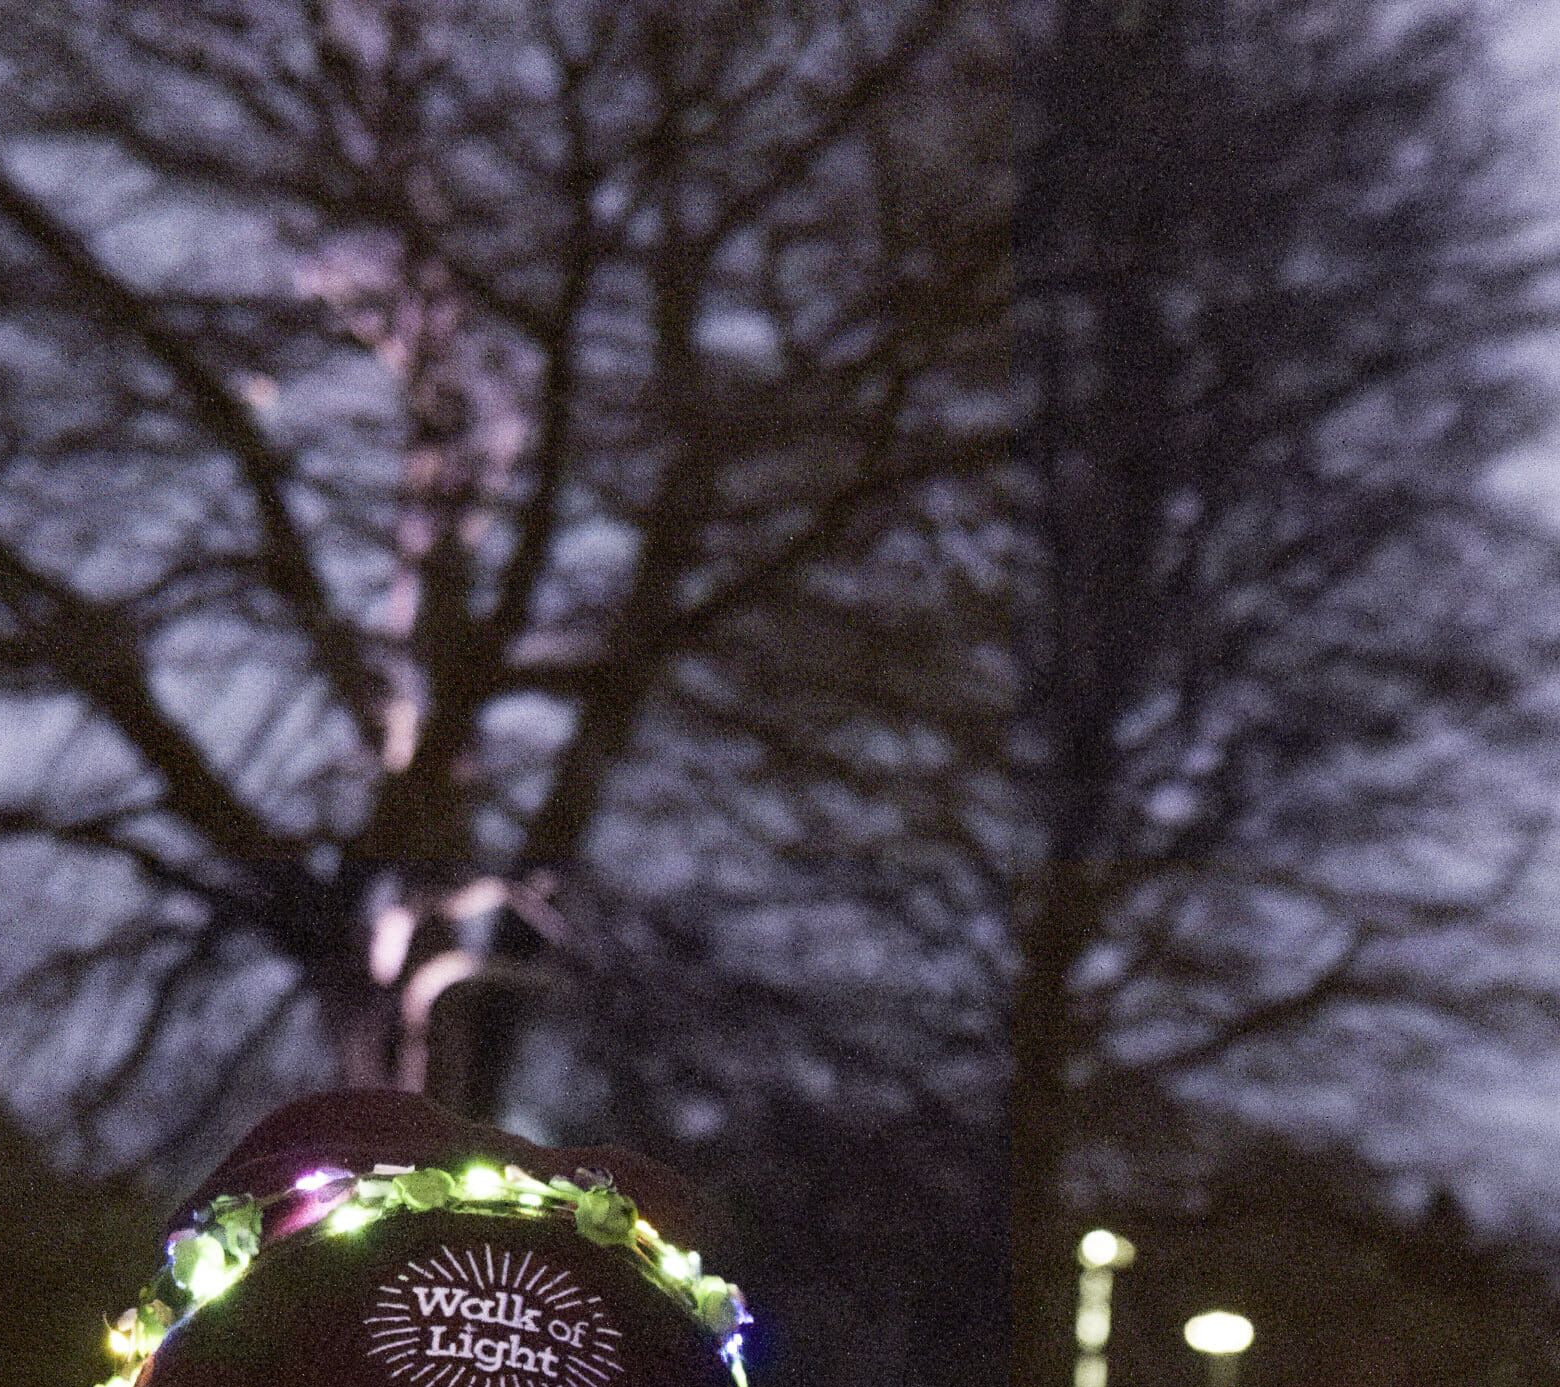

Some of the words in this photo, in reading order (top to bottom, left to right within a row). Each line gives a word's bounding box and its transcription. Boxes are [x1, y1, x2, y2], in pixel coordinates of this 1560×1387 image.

[412, 1286, 541, 1332] Walk
[548, 1319, 589, 1348] of
[426, 1322, 559, 1377] Light
